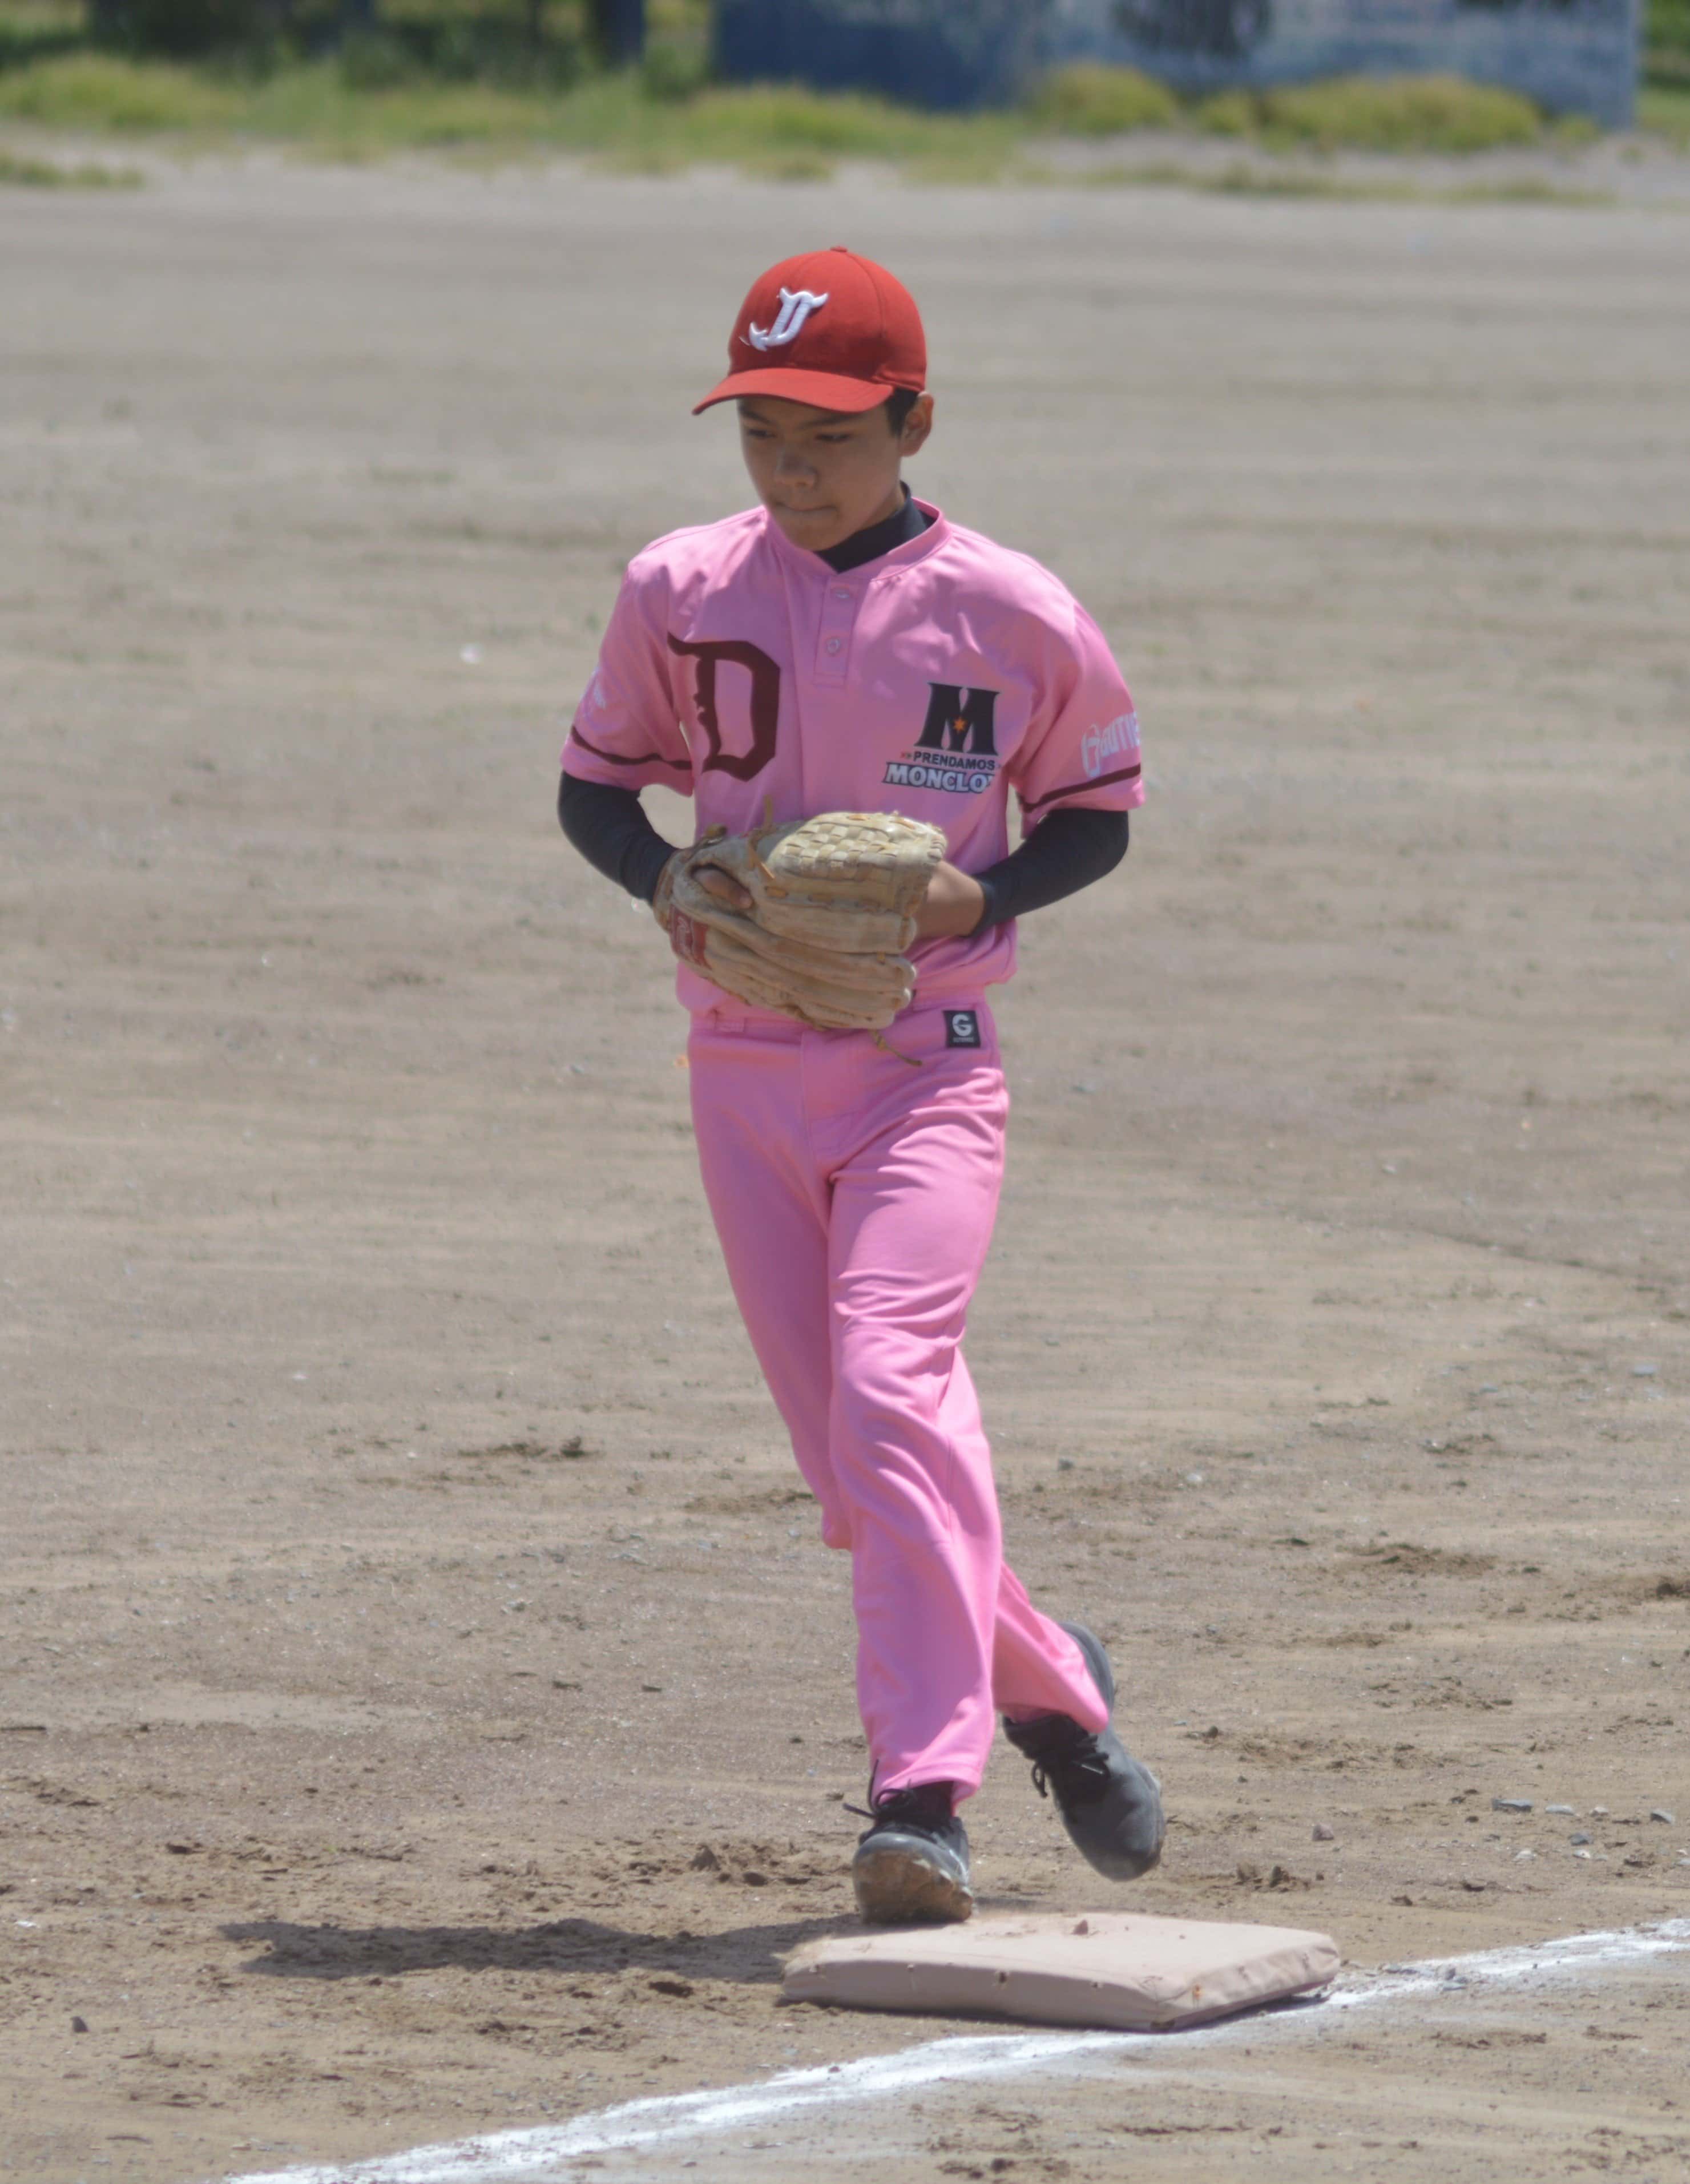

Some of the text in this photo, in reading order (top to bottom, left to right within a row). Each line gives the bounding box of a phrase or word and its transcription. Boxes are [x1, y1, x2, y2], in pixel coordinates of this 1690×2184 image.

[667, 631, 781, 782] D
[913, 682, 1001, 756] M
[952, 1014, 972, 1036] G
